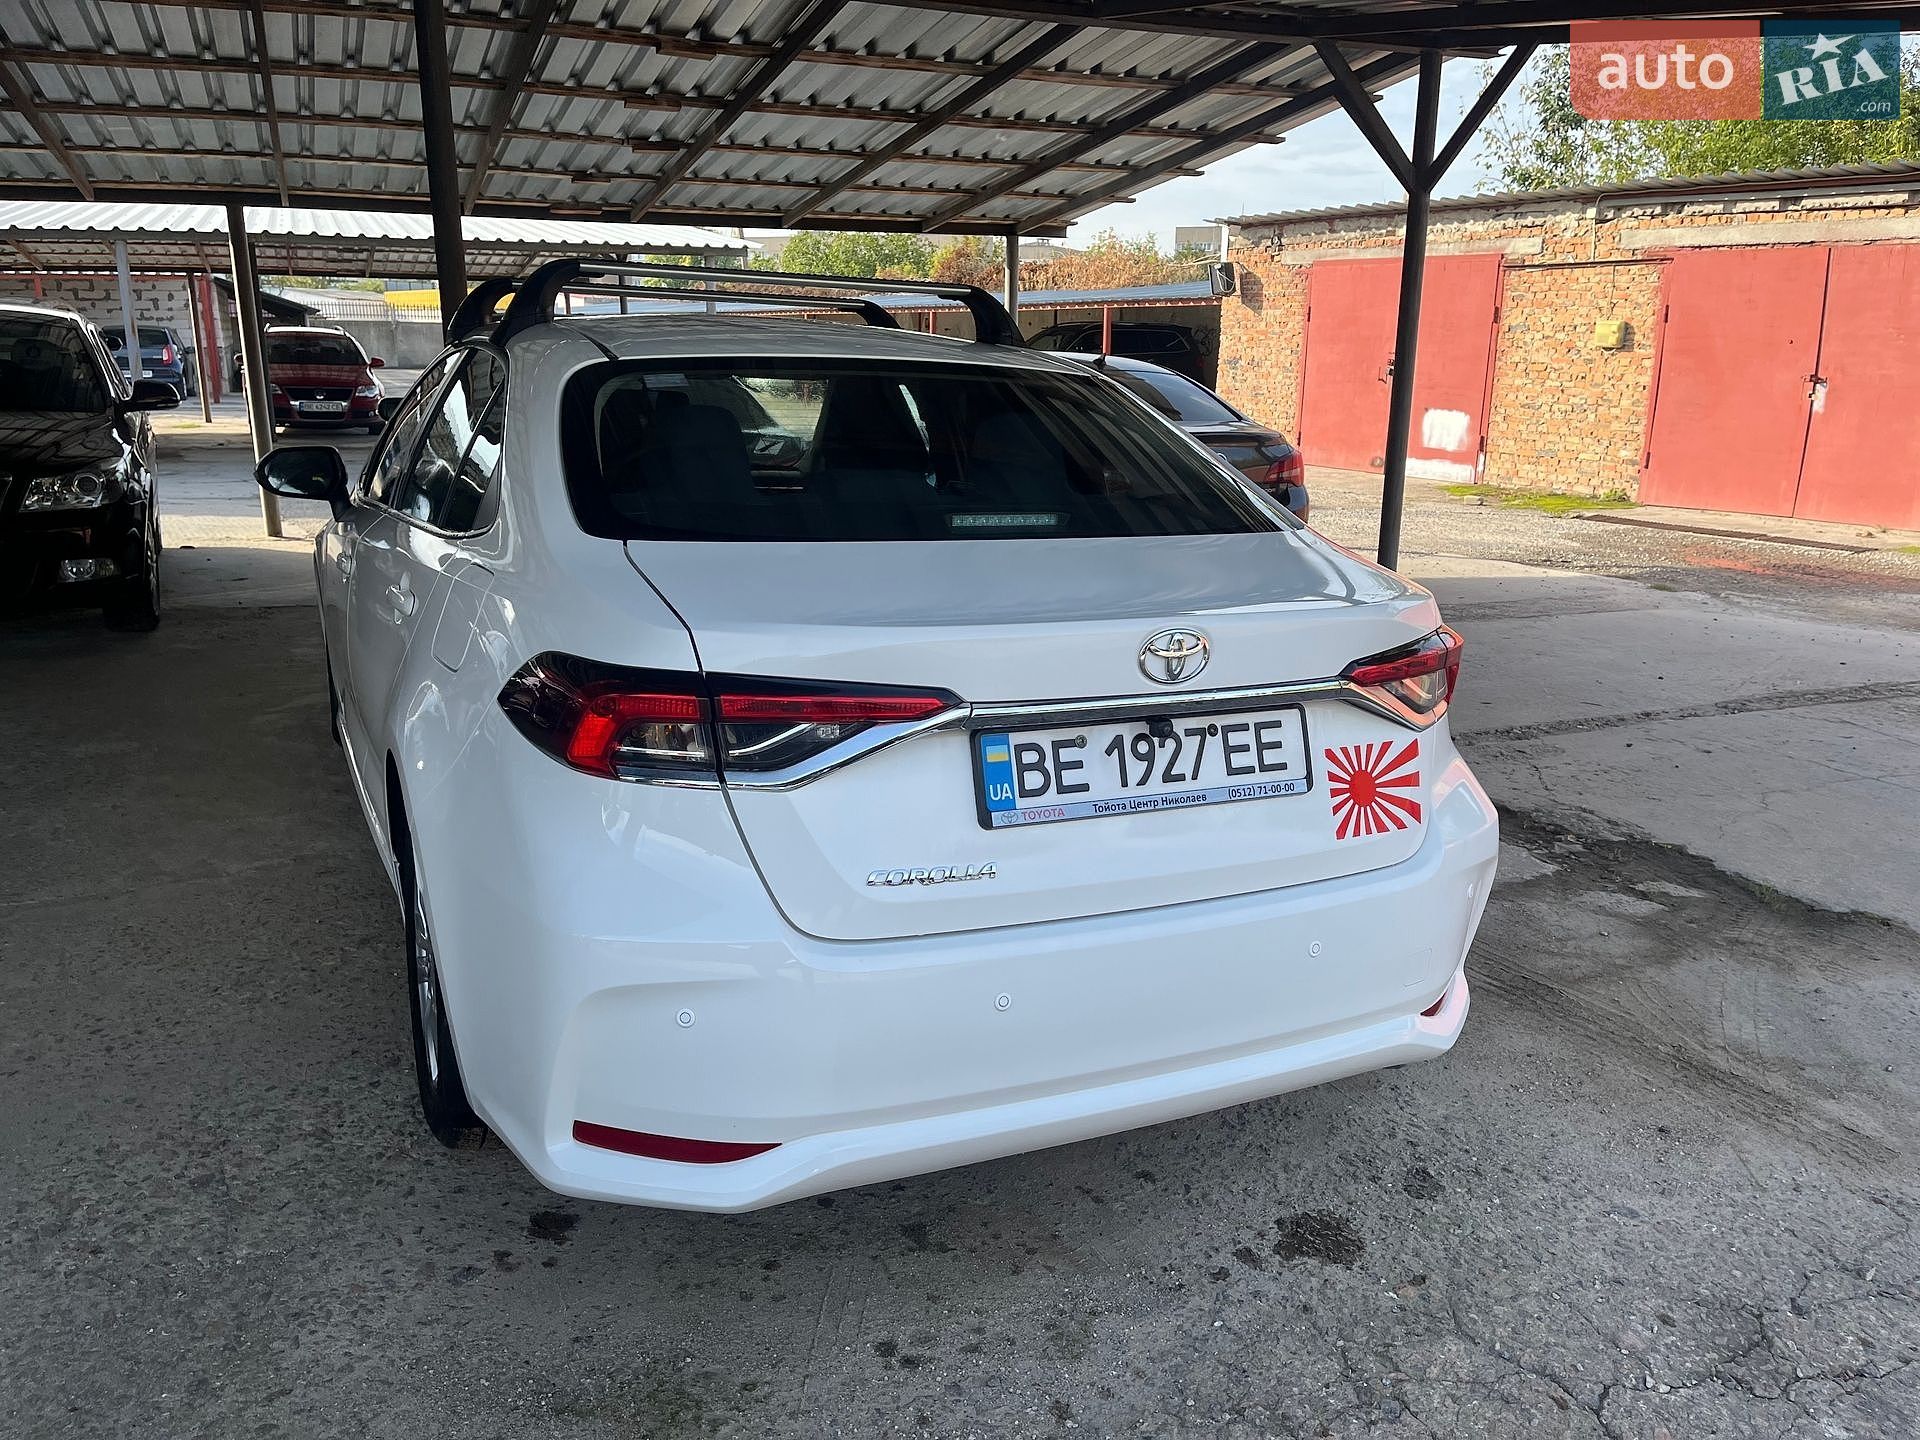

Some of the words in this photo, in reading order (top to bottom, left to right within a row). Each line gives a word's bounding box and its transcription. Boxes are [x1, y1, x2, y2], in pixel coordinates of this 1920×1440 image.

[1013, 738, 1091, 799] BE
[1104, 727, 1207, 788] 1927
[1221, 719, 1288, 777] EE
[989, 783, 1013, 801] UA
[1227, 785, 1256, 800] (0512)
[1257, 782, 1296, 796] 71-00-00
[1092, 801, 1128, 814] Тойота
[1129, 798, 1159, 811] Центр
[1161, 792, 1208, 807] Николаев
[1021, 808, 1066, 821] TOYOTA
[866, 860, 998, 887] COROLLA
